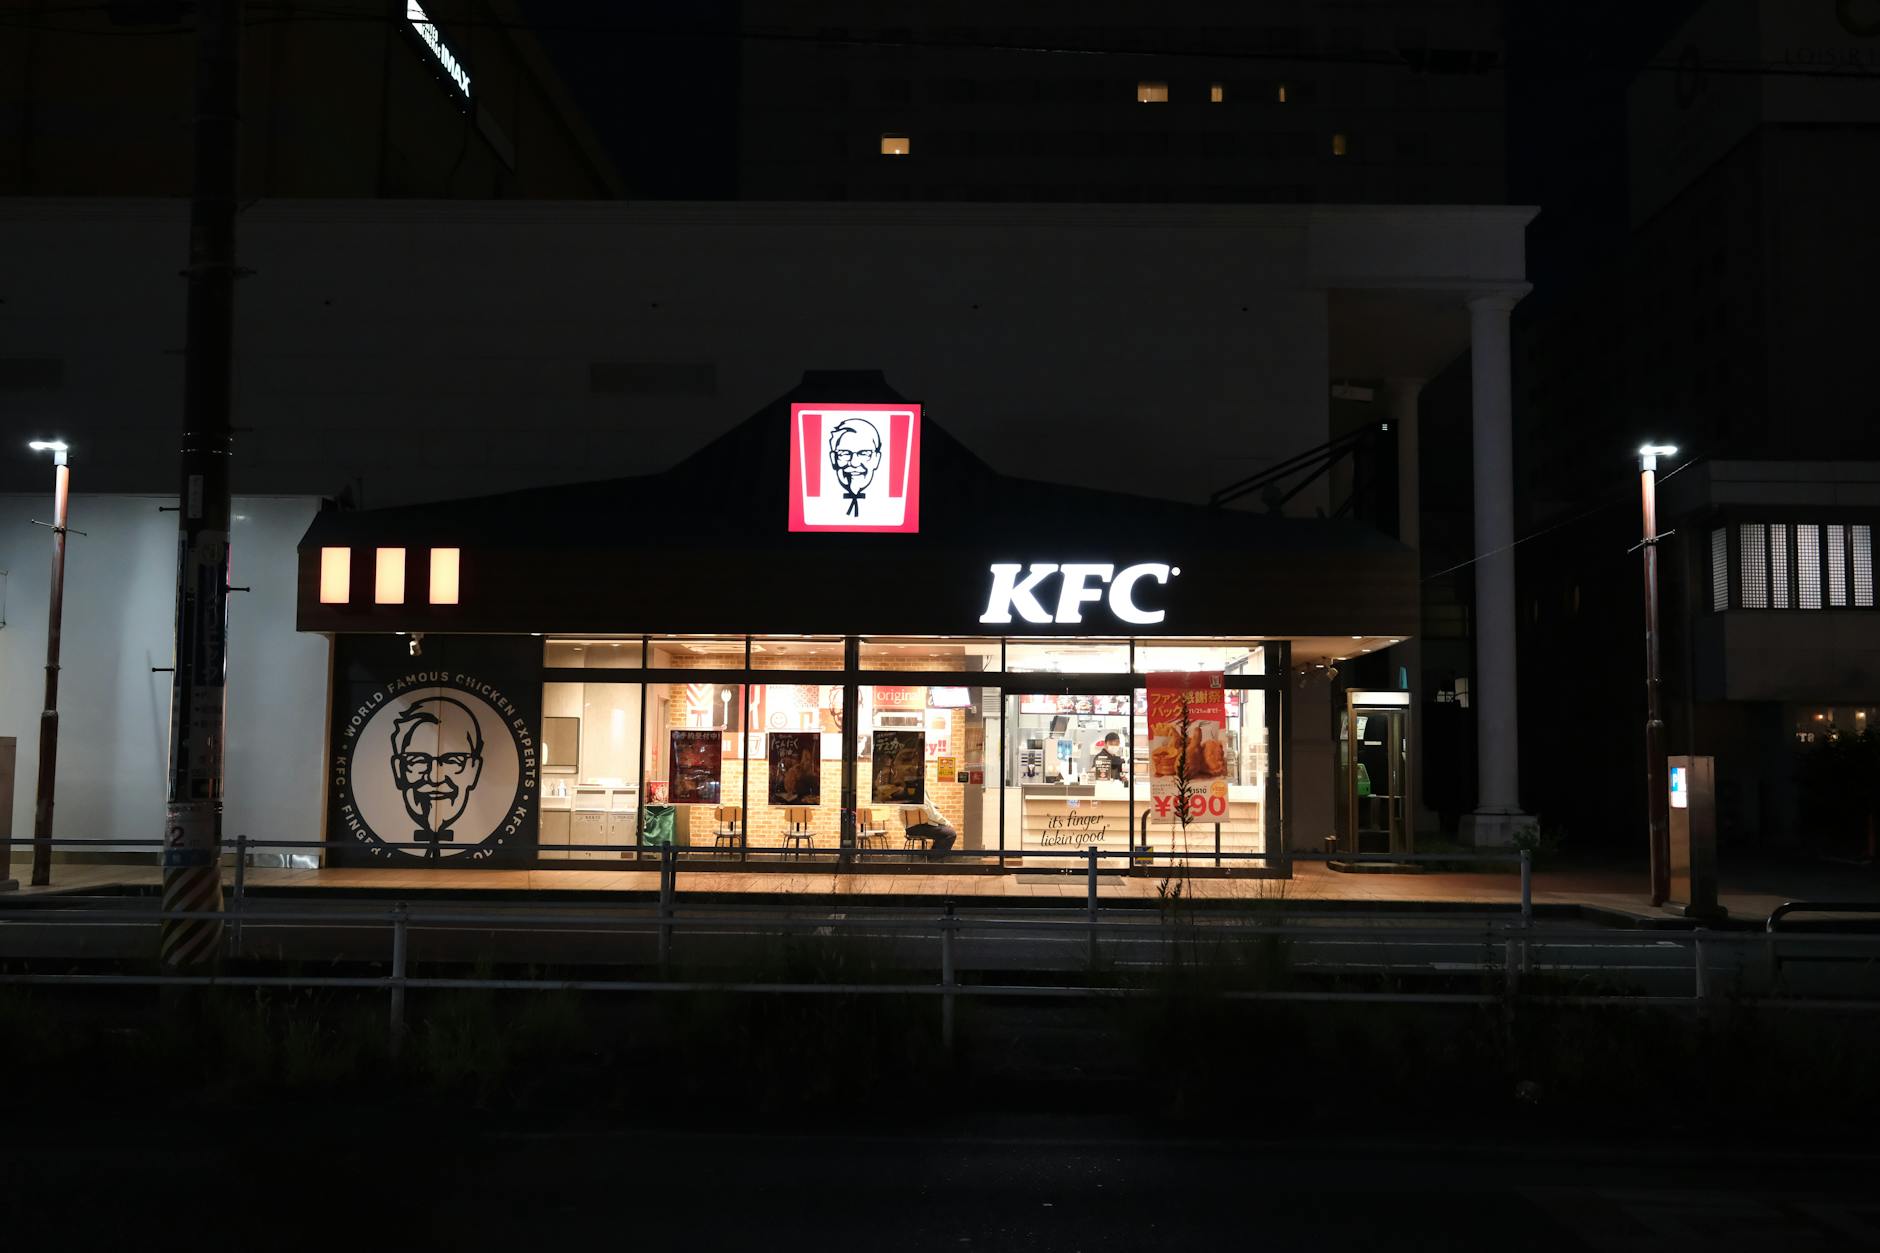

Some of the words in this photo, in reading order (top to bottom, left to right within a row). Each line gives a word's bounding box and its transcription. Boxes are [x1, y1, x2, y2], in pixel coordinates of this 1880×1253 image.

[441, 43, 471, 98] IMAX
[979, 563, 1170, 624] KFC
[344, 692, 384, 737] WORLD
[386, 671, 449, 694] FAMOUS
[456, 674, 515, 716] CHICKEN
[513, 718, 536, 788] EXPERTS
[335, 756, 346, 785] KFC
[505, 806, 528, 835] KFC
[1067, 810, 1104, 831] finger
